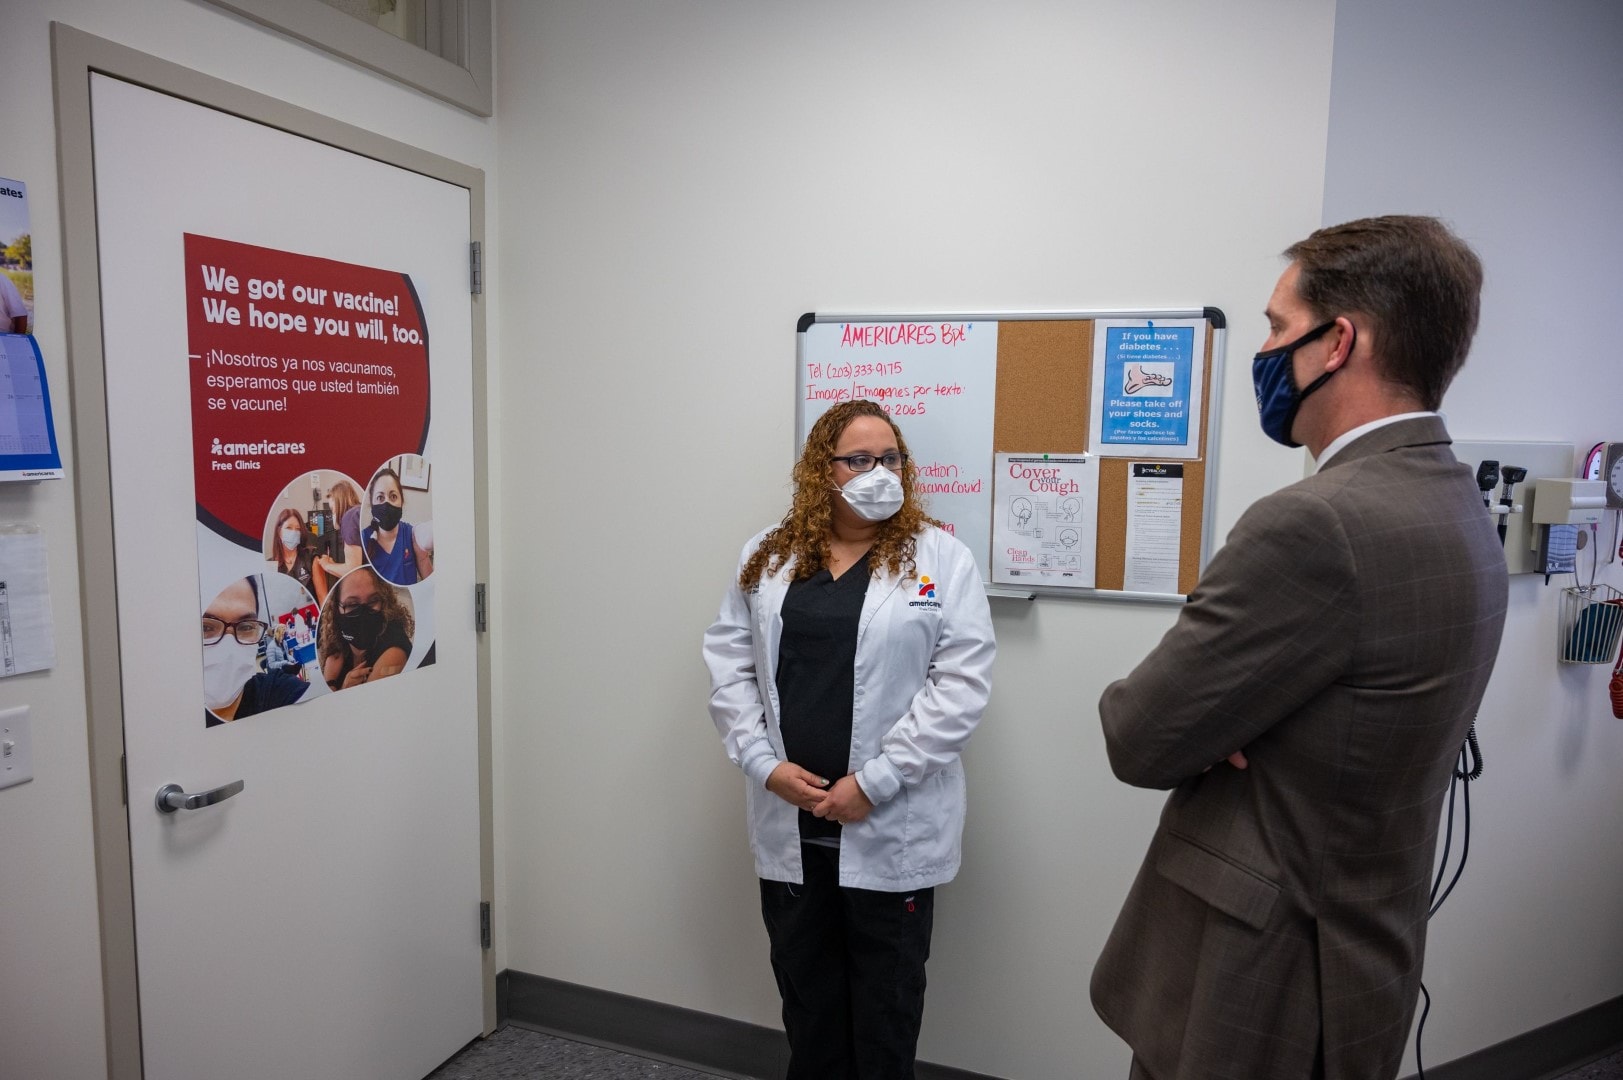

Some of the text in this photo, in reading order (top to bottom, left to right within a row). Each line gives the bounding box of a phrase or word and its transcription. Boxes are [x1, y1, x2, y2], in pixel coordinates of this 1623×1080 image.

[0, 187, 23, 198] ates
[201, 264, 399, 317] We got our vaccine!
[202, 297, 424, 346] We hope you will, too.
[840, 323, 967, 348] AMERICARES Bpt
[1122, 332, 1178, 342] If you have
[1119, 342, 1161, 351] diabetes
[206, 348, 396, 379] ¡Nosotros ya nos vacunamos,
[826, 361, 853, 380] (203)
[853, 360, 903, 379] 333-9175
[206, 375, 400, 396] esperamos que usted también
[913, 384, 932, 400] por
[207, 396, 288, 412] se vacune!
[1110, 399, 1183, 409] Please take off
[1108, 410, 1183, 419] your shoes and
[1129, 419, 1160, 429] socks.
[223, 439, 306, 456] americares
[211, 459, 261, 471] Free Clinics
[1009, 463, 1061, 479] Cover
[1029, 478, 1080, 496] Cough
